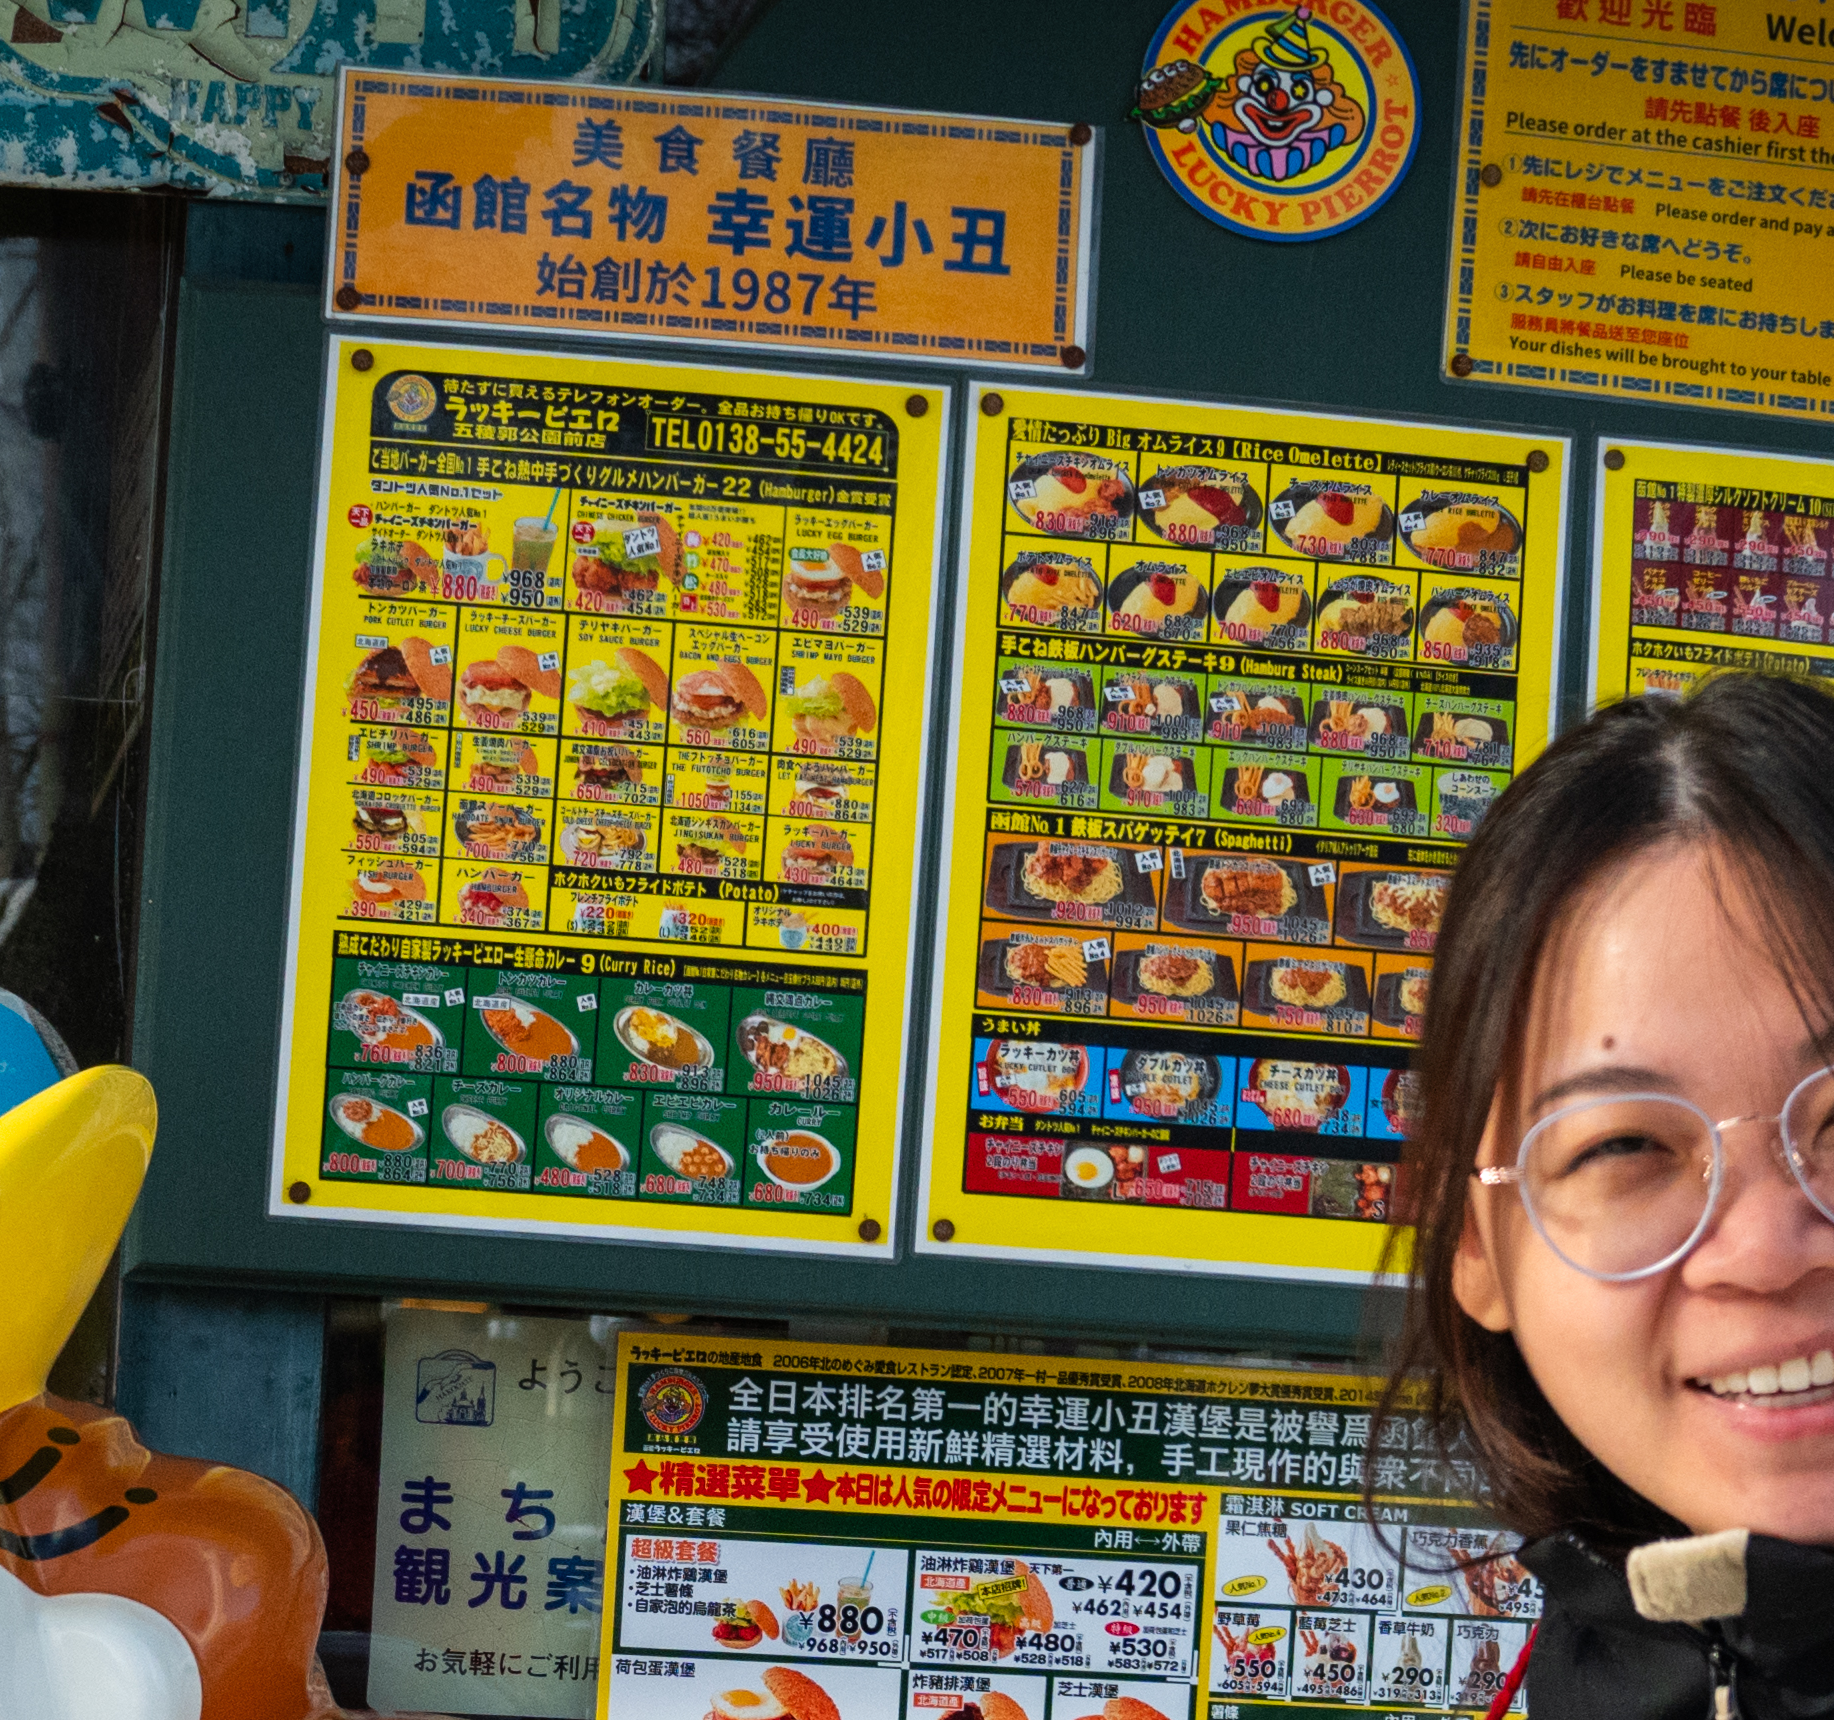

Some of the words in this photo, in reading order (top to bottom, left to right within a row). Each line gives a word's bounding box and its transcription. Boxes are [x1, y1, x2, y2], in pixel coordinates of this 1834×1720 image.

[1506, 112, 1568, 137] Please
[1573, 120, 1627, 142] order
[1631, 128, 1650, 143] at
[1655, 127, 1688, 148] the
[1691, 131, 1762, 157] cashier
[1766, 139, 1807, 162] first
[572, 118, 856, 189] 美食餐廳
[1172, 142, 1289, 226] LUCKY
[1298, 98, 1409, 226] PIERROT
[404, 169, 669, 245] 函館名物
[706, 187, 1013, 277] 幸運小丑
[1655, 203, 1706, 220] Please
[1711, 211, 1756, 228] order
[1759, 215, 1788, 232] and
[1793, 219, 1823, 238] pay
[535, 252, 878, 321] 始創於1987年
[1620, 265, 1673, 285] Please
[1677, 270, 1697, 287] be
[1701, 273, 1753, 293] seated
[1508, 337, 1546, 355] Your
[1549, 340, 1601, 361] dishes
[1605, 346, 1635, 363] will
[1638, 349, 1658, 367] be
[1662, 353, 1726, 376] brought
[1730, 360, 1748, 375] to
[1752, 363, 1786, 383] your
[1791, 365, 1831, 387] table
[444, 396, 620, 432] ラッキーピエロ
[652, 416, 883, 465] TEL0138-55-4424
[1106, 428, 1131, 450] Big
[981, 1016, 1042, 1038] うまい丼
[979, 1113, 1025, 1132] お弁当
[659, 1460, 802, 1502] 精選菜單
[1224, 1494, 1285, 1517] 霜淇淋
[1290, 1502, 1342, 1520] SOFT
[631, 1538, 721, 1563] 超級套餐
[1098, 1569, 1182, 1598] ¥420
[921, 1628, 979, 1649] ¥470
[1016, 1633, 1076, 1652] ¥480
[1109, 1638, 1168, 1658] ¥530
[1382, 1667, 1434, 1687] ¥290
